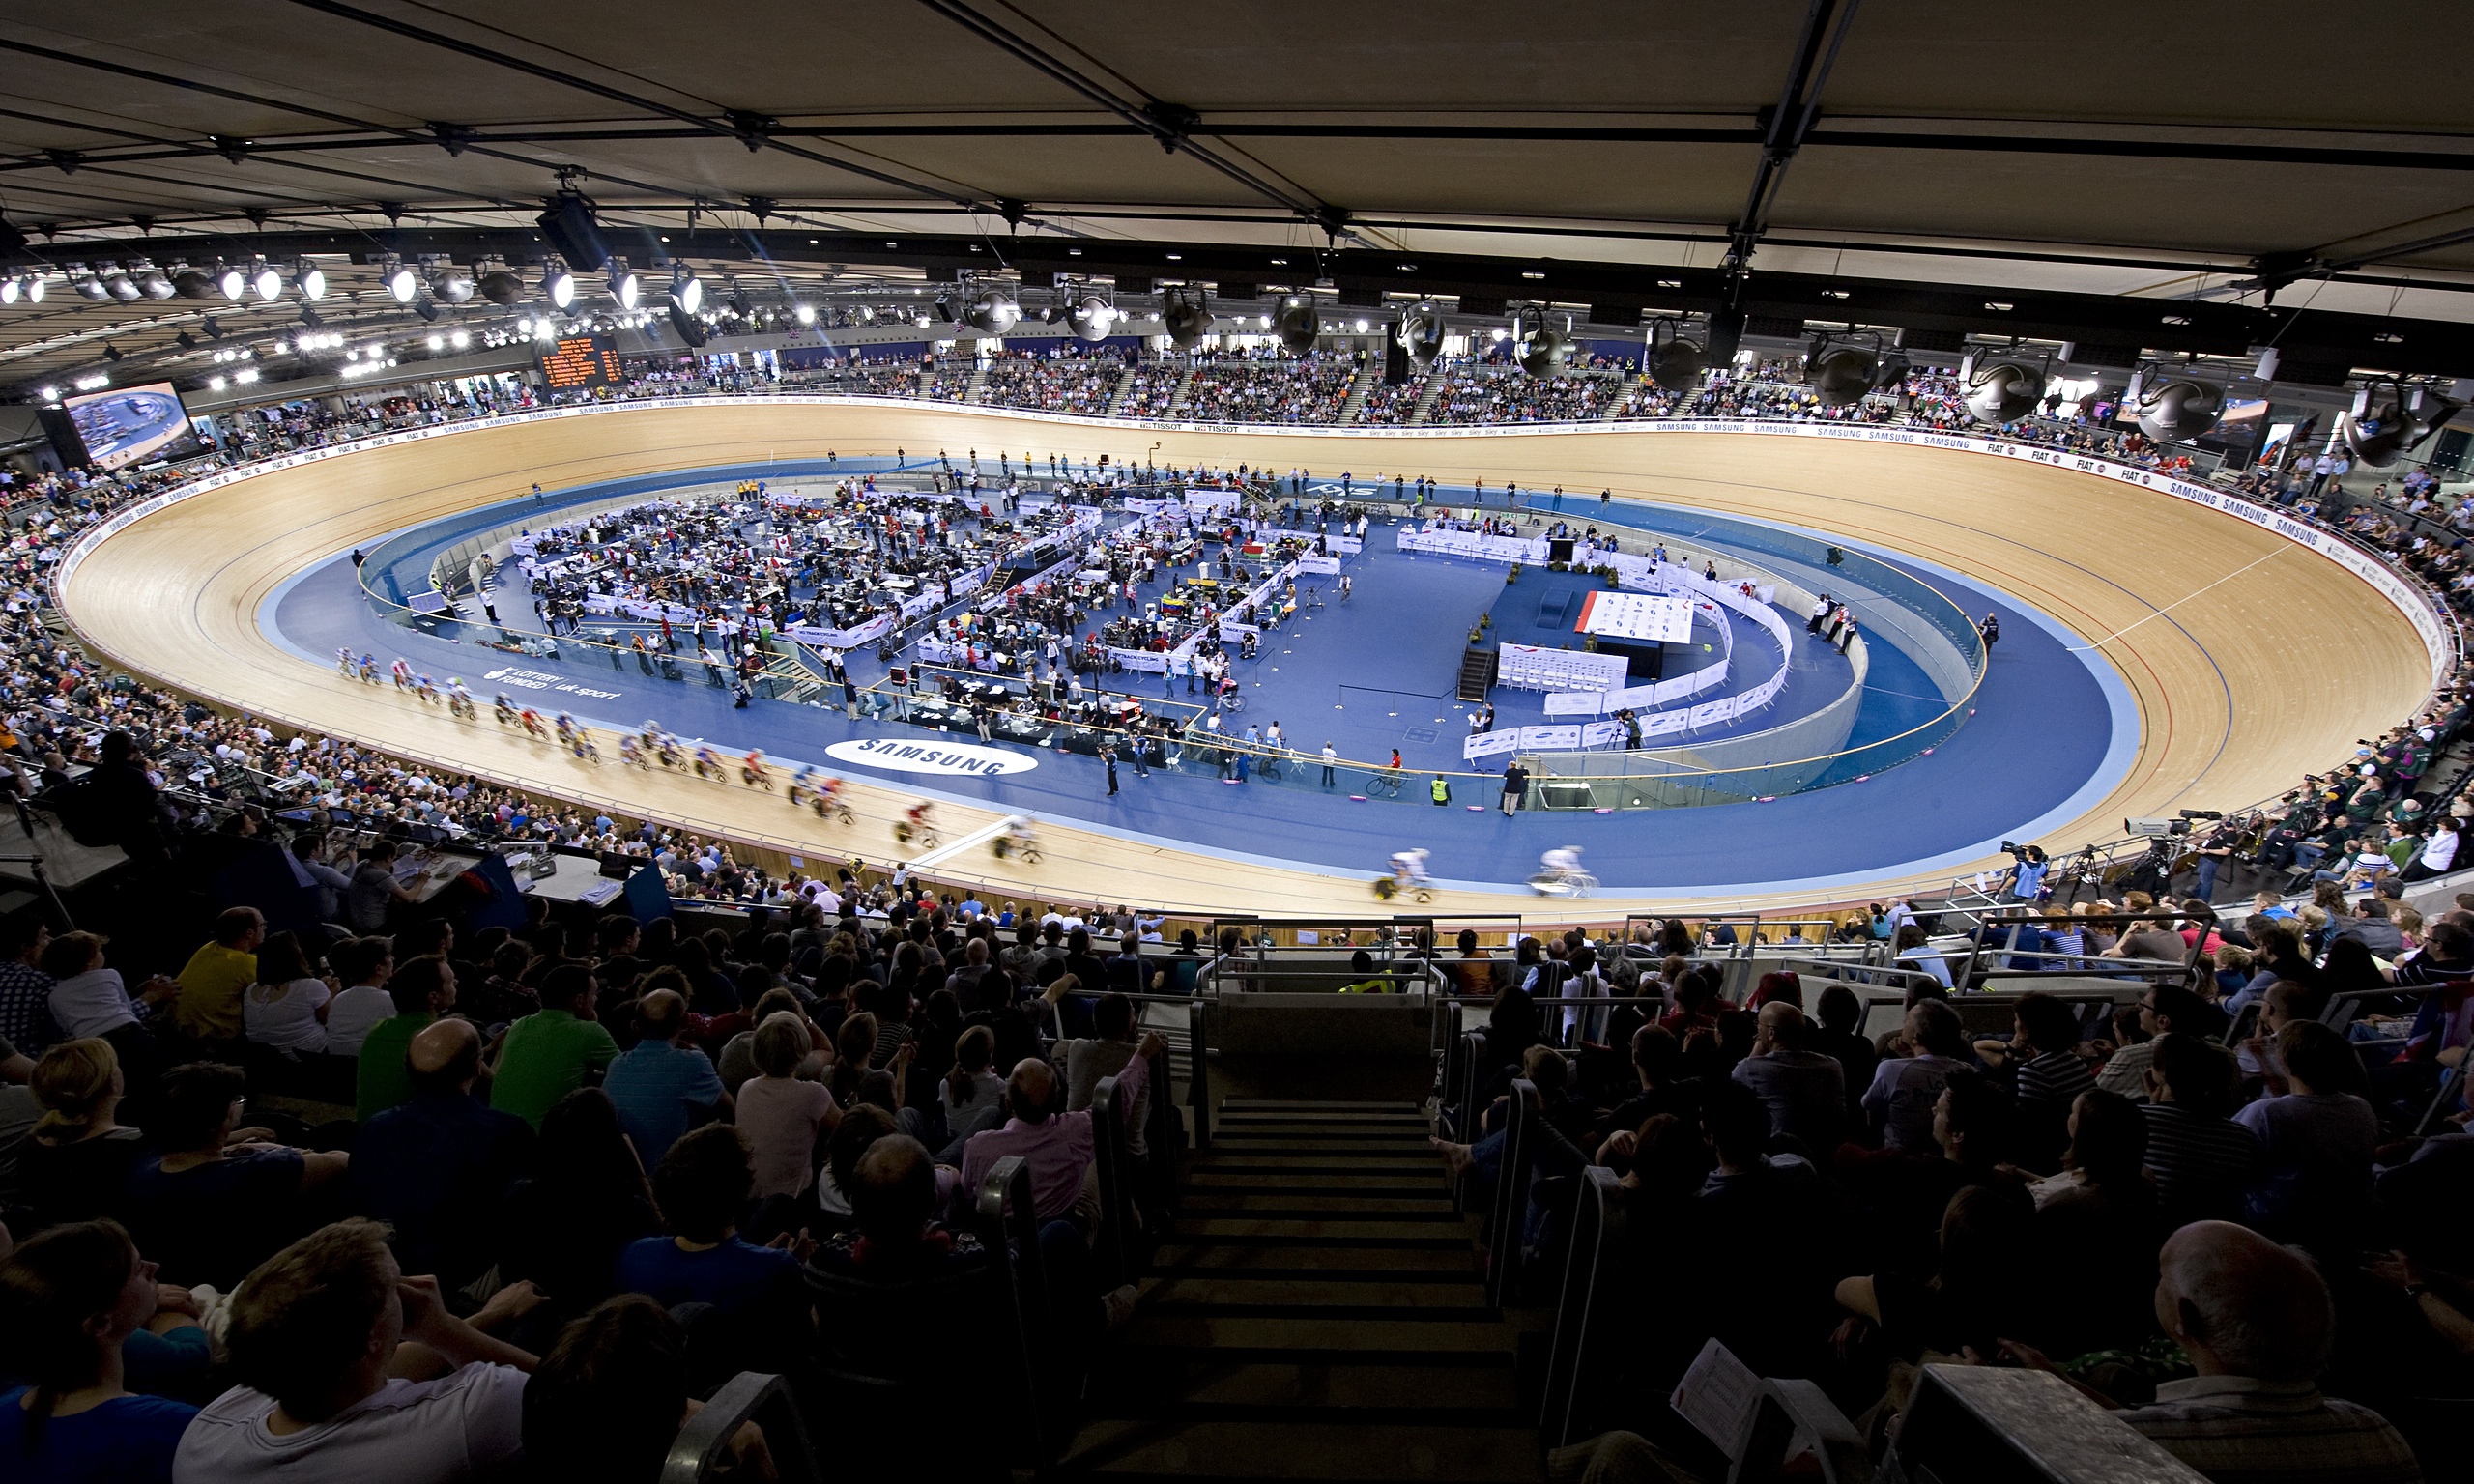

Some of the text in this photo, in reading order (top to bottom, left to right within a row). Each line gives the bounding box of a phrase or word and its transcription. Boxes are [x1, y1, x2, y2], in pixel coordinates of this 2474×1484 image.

[579, 405, 614, 414] SAMSUNG
[529, 411, 563, 420] SAMSUNG
[485, 416, 521, 427] SAMSUNG
[444, 422, 479, 433] SAMSUNG
[1817, 428, 1861, 438] SAMSUNG
[1869, 432, 1913, 442] SAMSUNG
[1924, 437, 1970, 448] SAMSUNG
[1987, 444, 2004, 454] FIAT
[304, 453, 317, 462] FIAT
[2031, 451, 2049, 461] FIAT
[272, 461, 284, 470] FIAT
[2077, 460, 2094, 471] FIAT
[240, 470, 252, 478] FIAT
[2121, 470, 2140, 482] FIAT
[210, 478, 221, 488] FIAT
[168, 485, 199, 501] SAMSUNG
[2171, 483, 2217, 504] SAMSUNG
[135, 499, 164, 517] SAMSUNG
[2223, 499, 2267, 524] SAMSUNG
[109, 513, 134, 531] SAMSUNG
[2275, 519, 2318, 545] SAMSUNG
[513, 671, 565, 682] LOTTERY
[497, 676, 548, 690] FUNDED
[575, 688, 621, 699] sport
[858, 739, 1005, 775] SAMSUNG
